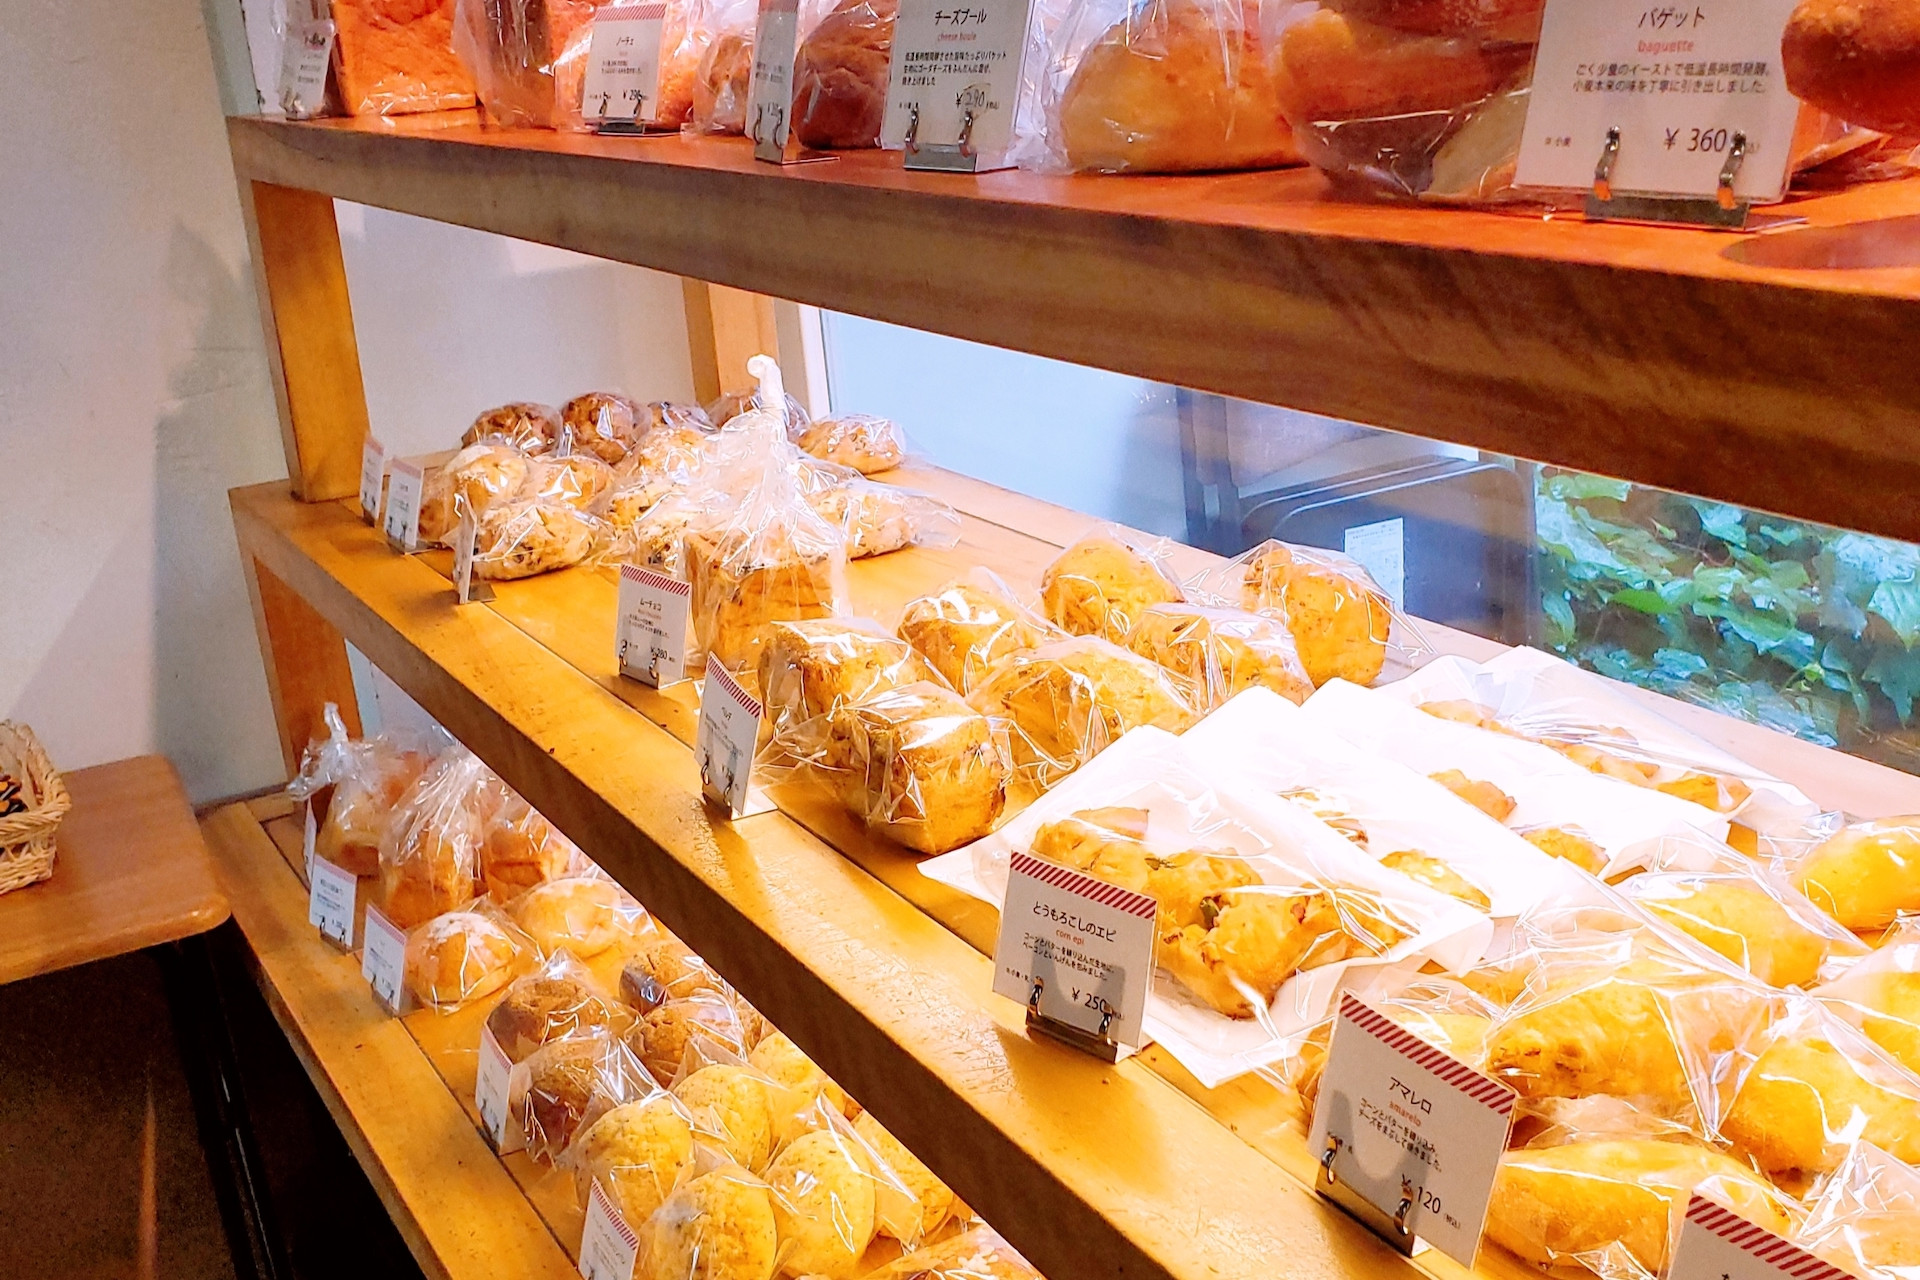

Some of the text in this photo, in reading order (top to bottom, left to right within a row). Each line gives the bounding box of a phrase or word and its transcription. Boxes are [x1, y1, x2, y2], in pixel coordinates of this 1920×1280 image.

[1638, 7, 1705, 29] バゲット
[1637, 39, 1695, 54] baguette
[1687, 128, 1727, 152] 360
[1033, 901, 1118, 943] とうもろこしのエピ
[1055, 929, 1072, 941] corn
[1389, 1076, 1433, 1116] アマレロ
[1388, 1100, 1422, 1128] amarelo
[1417, 1186, 1441, 1215] 120
